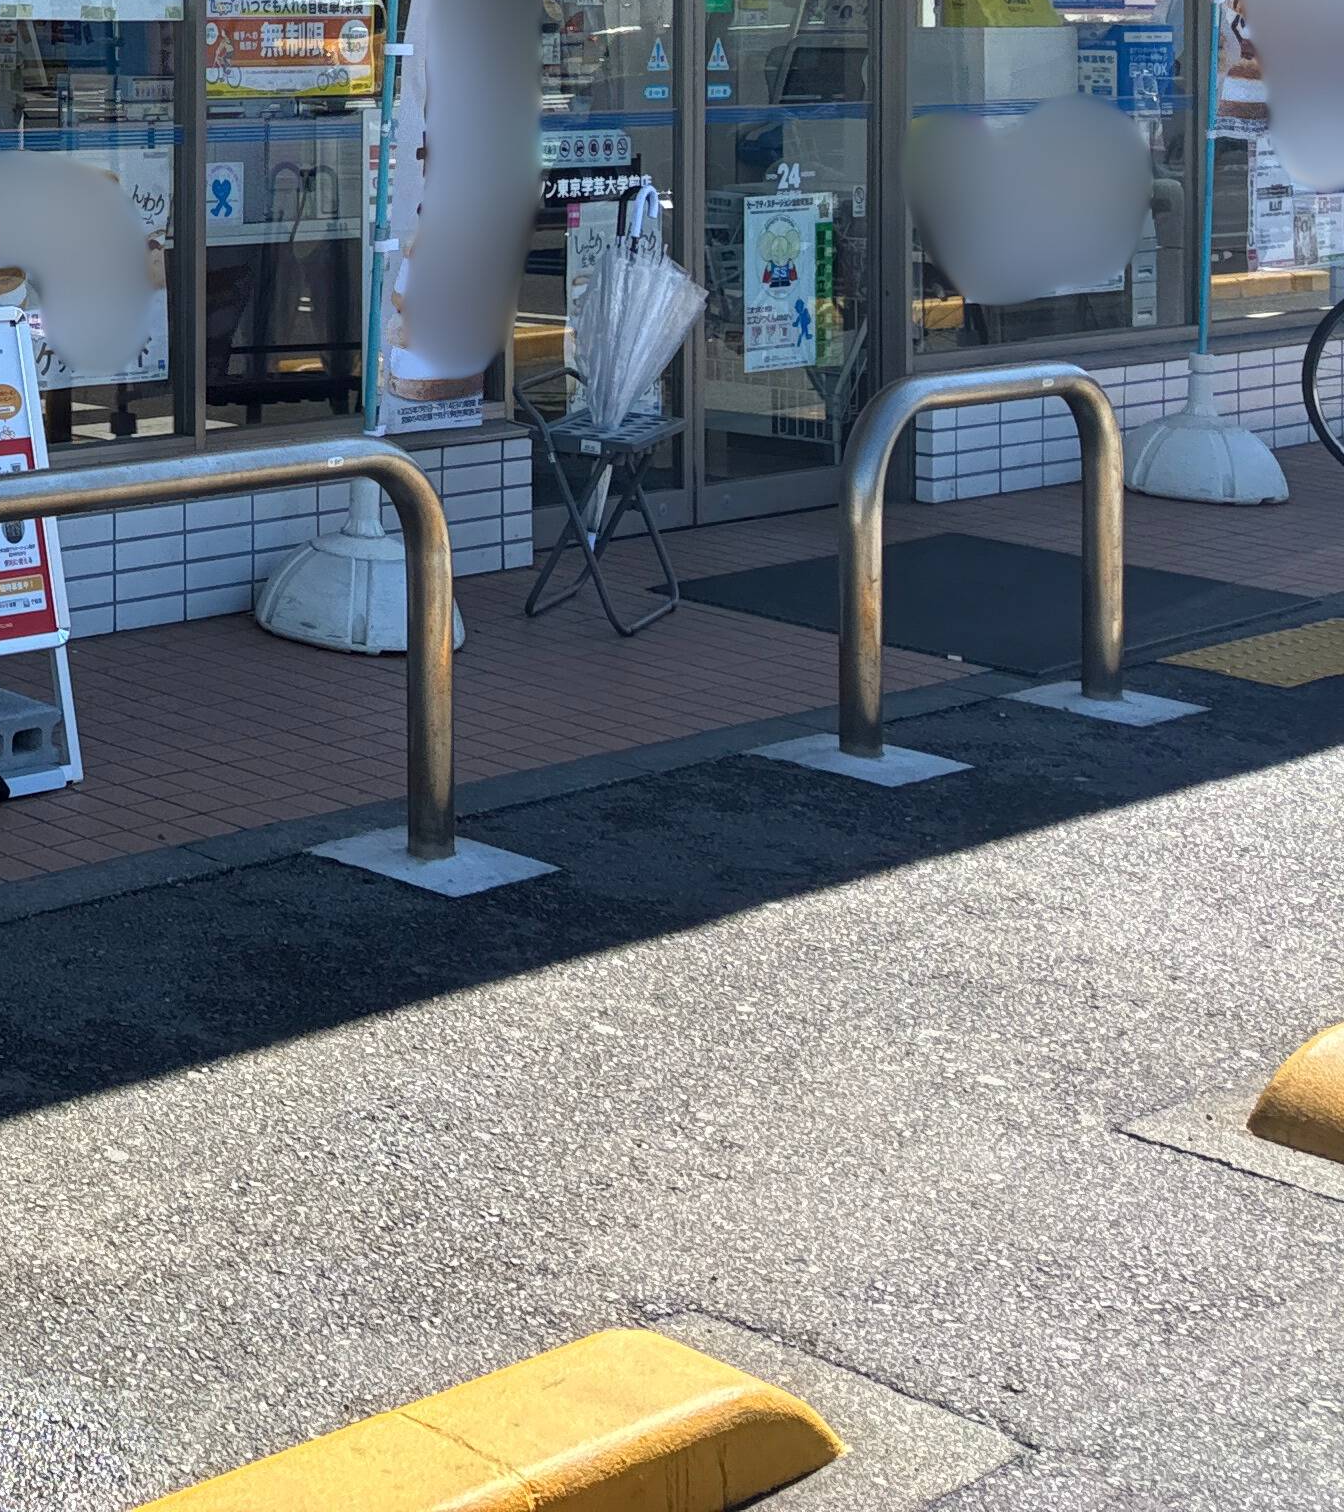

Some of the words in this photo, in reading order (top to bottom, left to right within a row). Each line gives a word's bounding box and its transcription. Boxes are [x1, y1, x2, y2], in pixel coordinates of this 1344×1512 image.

[777, 162, 801, 190] 24
[132, 184, 165, 215] んわり
